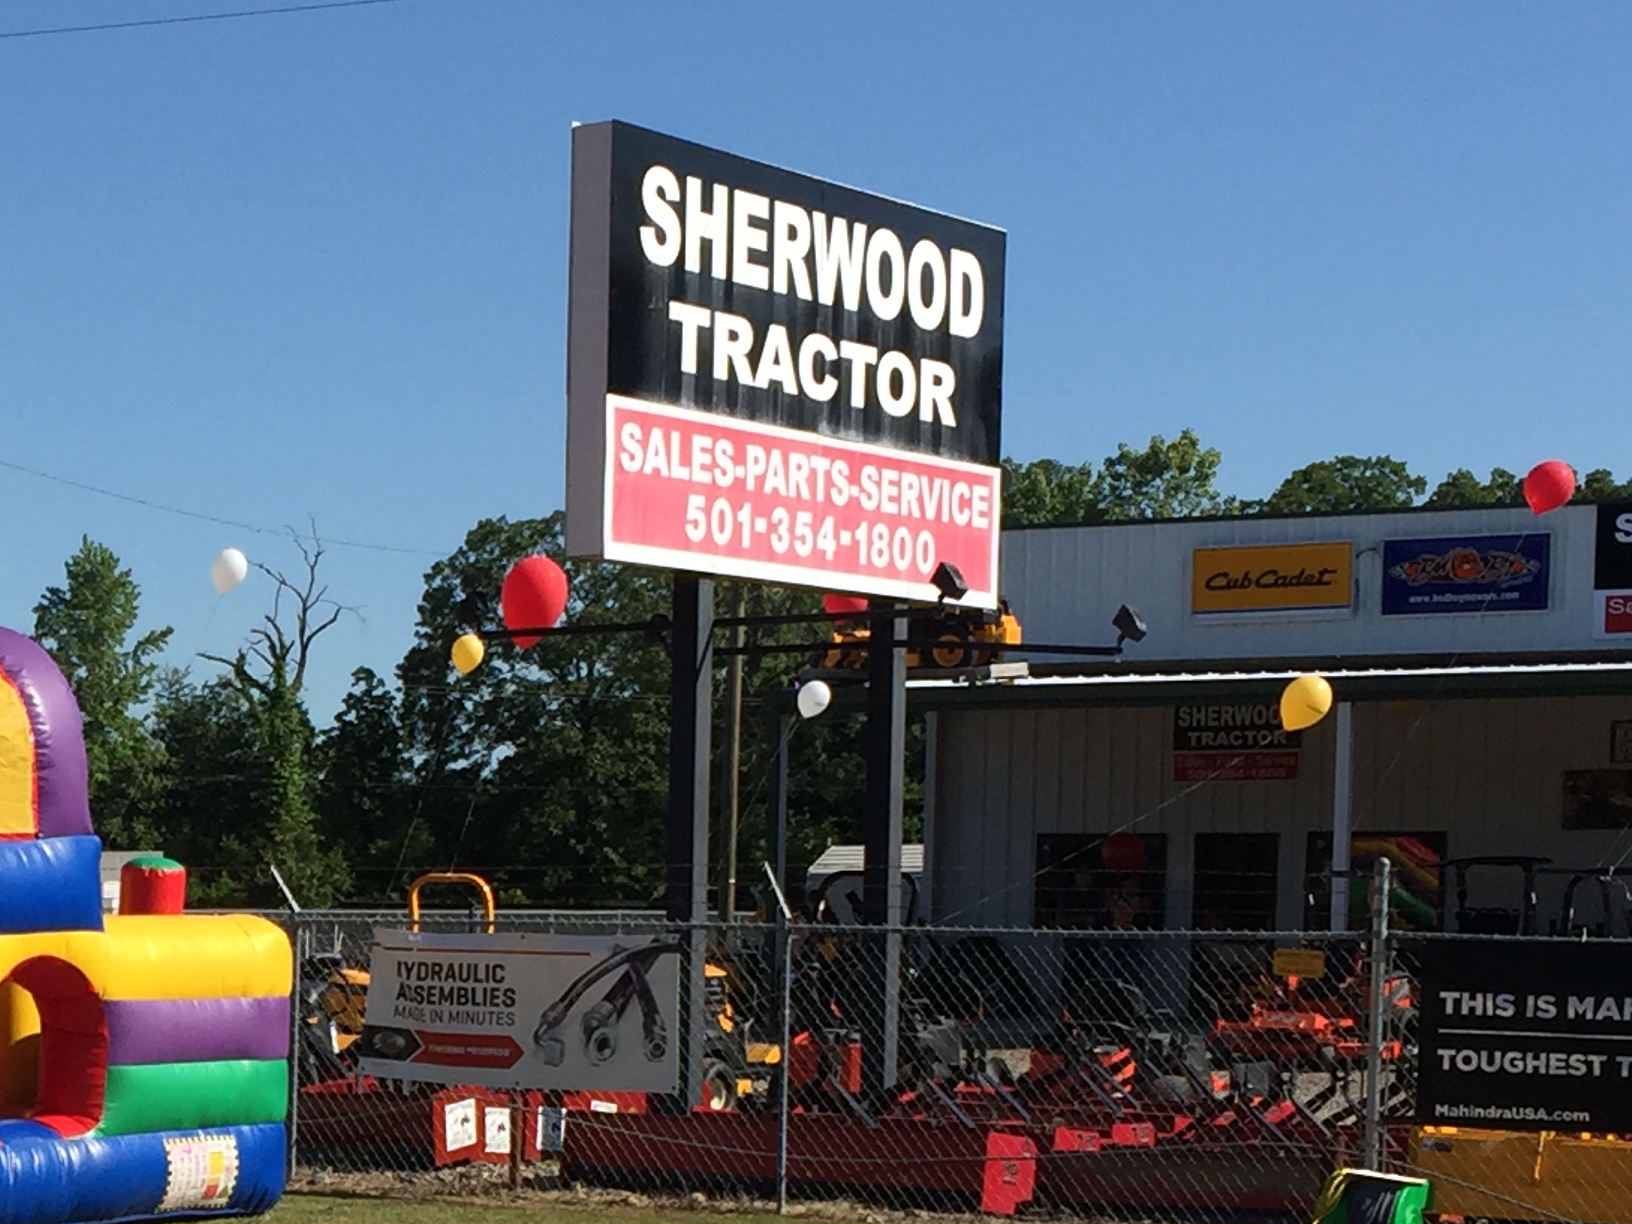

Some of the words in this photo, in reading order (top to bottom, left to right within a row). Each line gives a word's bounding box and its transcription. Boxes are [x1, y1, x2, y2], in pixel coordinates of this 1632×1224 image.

[639, 164, 985, 339] SHERWOOD
[668, 300, 957, 427] TRACTOR
[619, 423, 990, 530] SALES-PARTS-SERVICE
[685, 494, 935, 575] 501-354-1800
[1204, 571, 1252, 591] Cub
[1255, 568, 1338, 588] Cadet
[1178, 704, 1280, 728] SHERWOO
[1187, 730, 1287, 746] TRACTOR
[448, 1010, 516, 1027] MINUTES
[1439, 991, 1516, 1018] THIS
[1526, 994, 1558, 1019] IS
[1437, 1048, 1608, 1077] TOUGHEST
[1435, 1103, 1591, 1122] MahindraUSA.com
